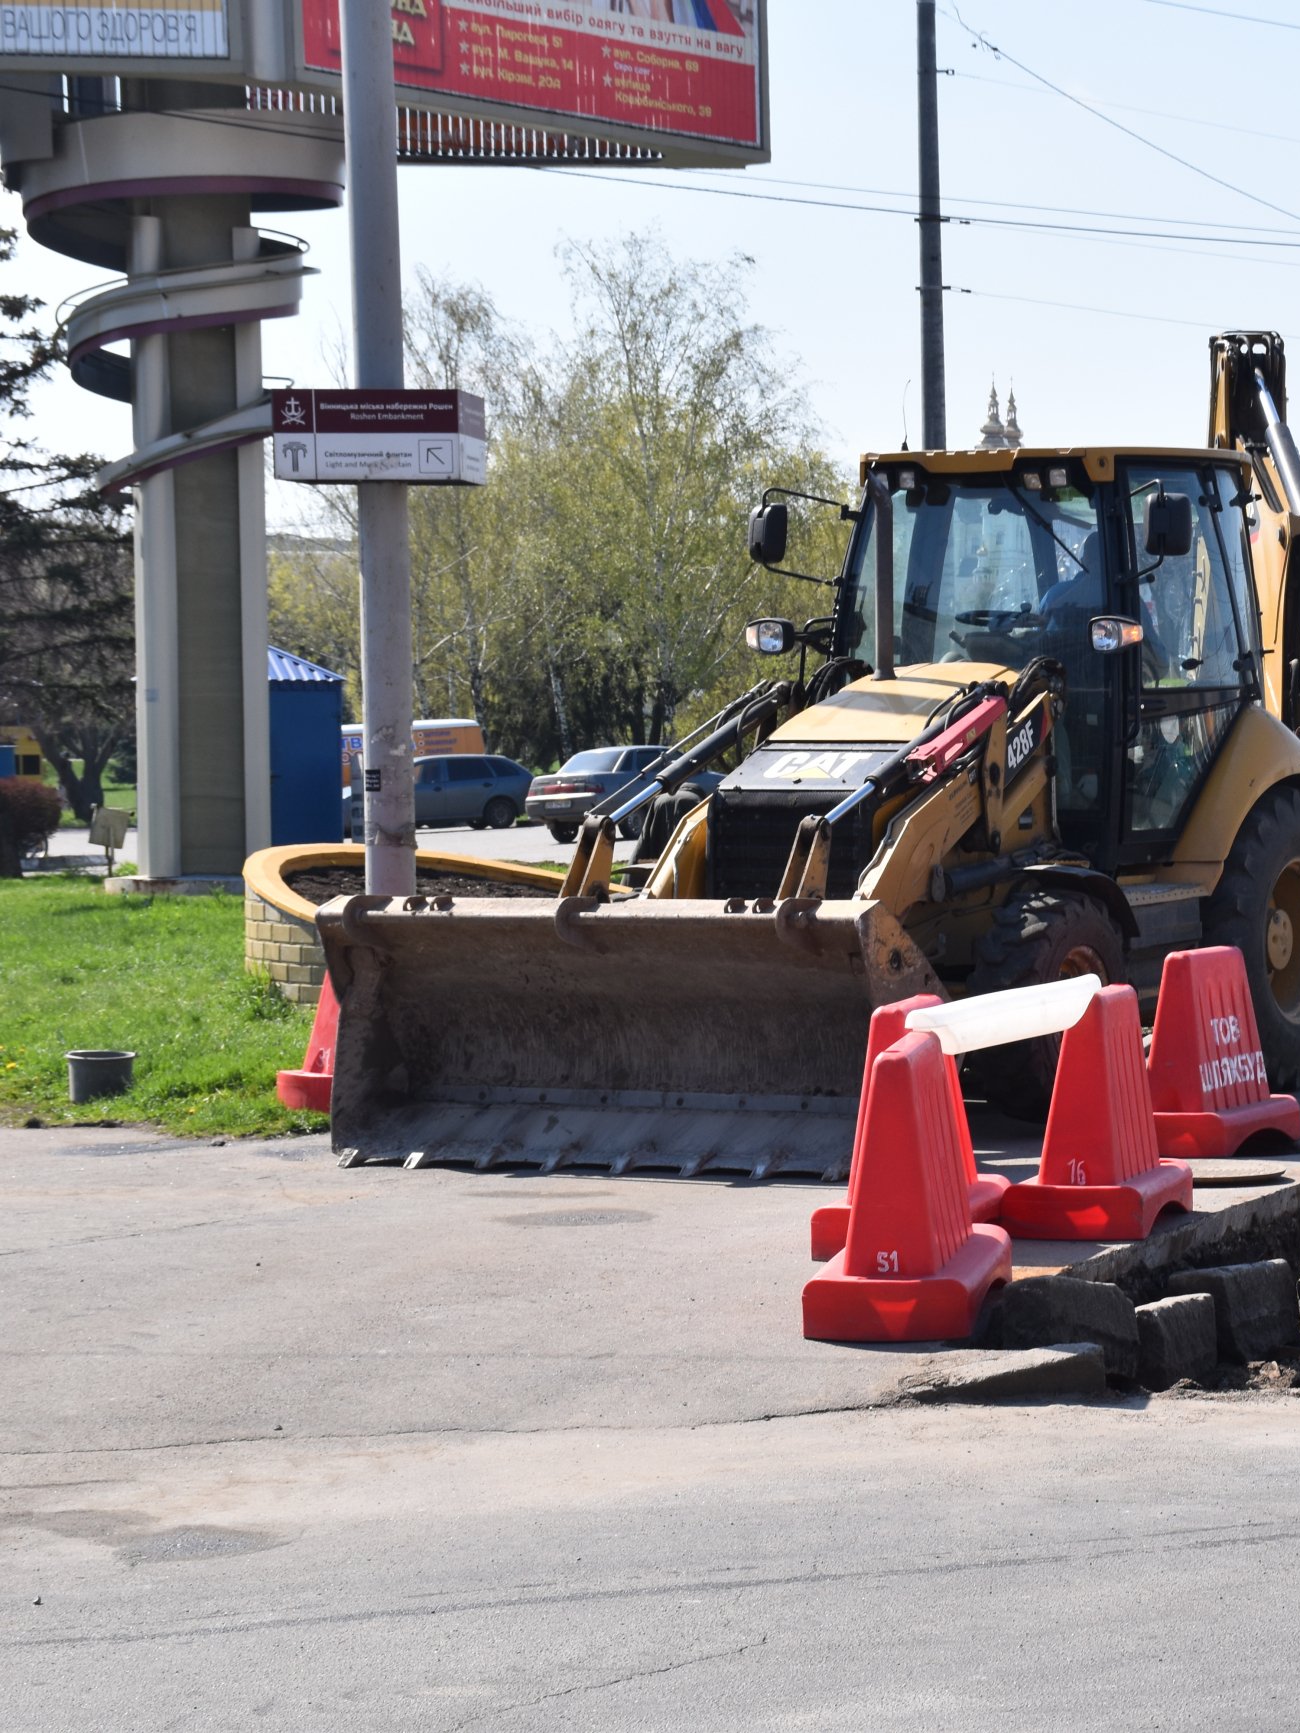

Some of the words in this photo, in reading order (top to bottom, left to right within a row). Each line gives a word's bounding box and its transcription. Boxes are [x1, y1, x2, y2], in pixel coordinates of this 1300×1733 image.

[3, 10, 92, 42] ВАШОГО
[97, 12, 198, 47] ЗДОРОВ'Я
[547, 8, 583, 25] вибір
[588, 18, 625, 36] одягу
[631, 25, 645, 37] та
[650, 29, 692, 45] взуття
[697, 37, 711, 49] на
[716, 42, 744, 58] вагу
[498, 47, 511, 60] М.
[562, 58, 574, 71] 14
[614, 48, 634, 60] вул.
[637, 51, 683, 72] Соборна,
[350, 412, 376, 420] Roshen
[377, 412, 425, 420] Embankment
[386, 402, 428, 411] набережна
[344, 460, 358, 468] and
[1007, 719, 1034, 769] 428F
[763, 752, 873, 779] CAT
[1210, 1015, 1241, 1046] ТОВ
[1067, 1158, 1086, 1185] 16
